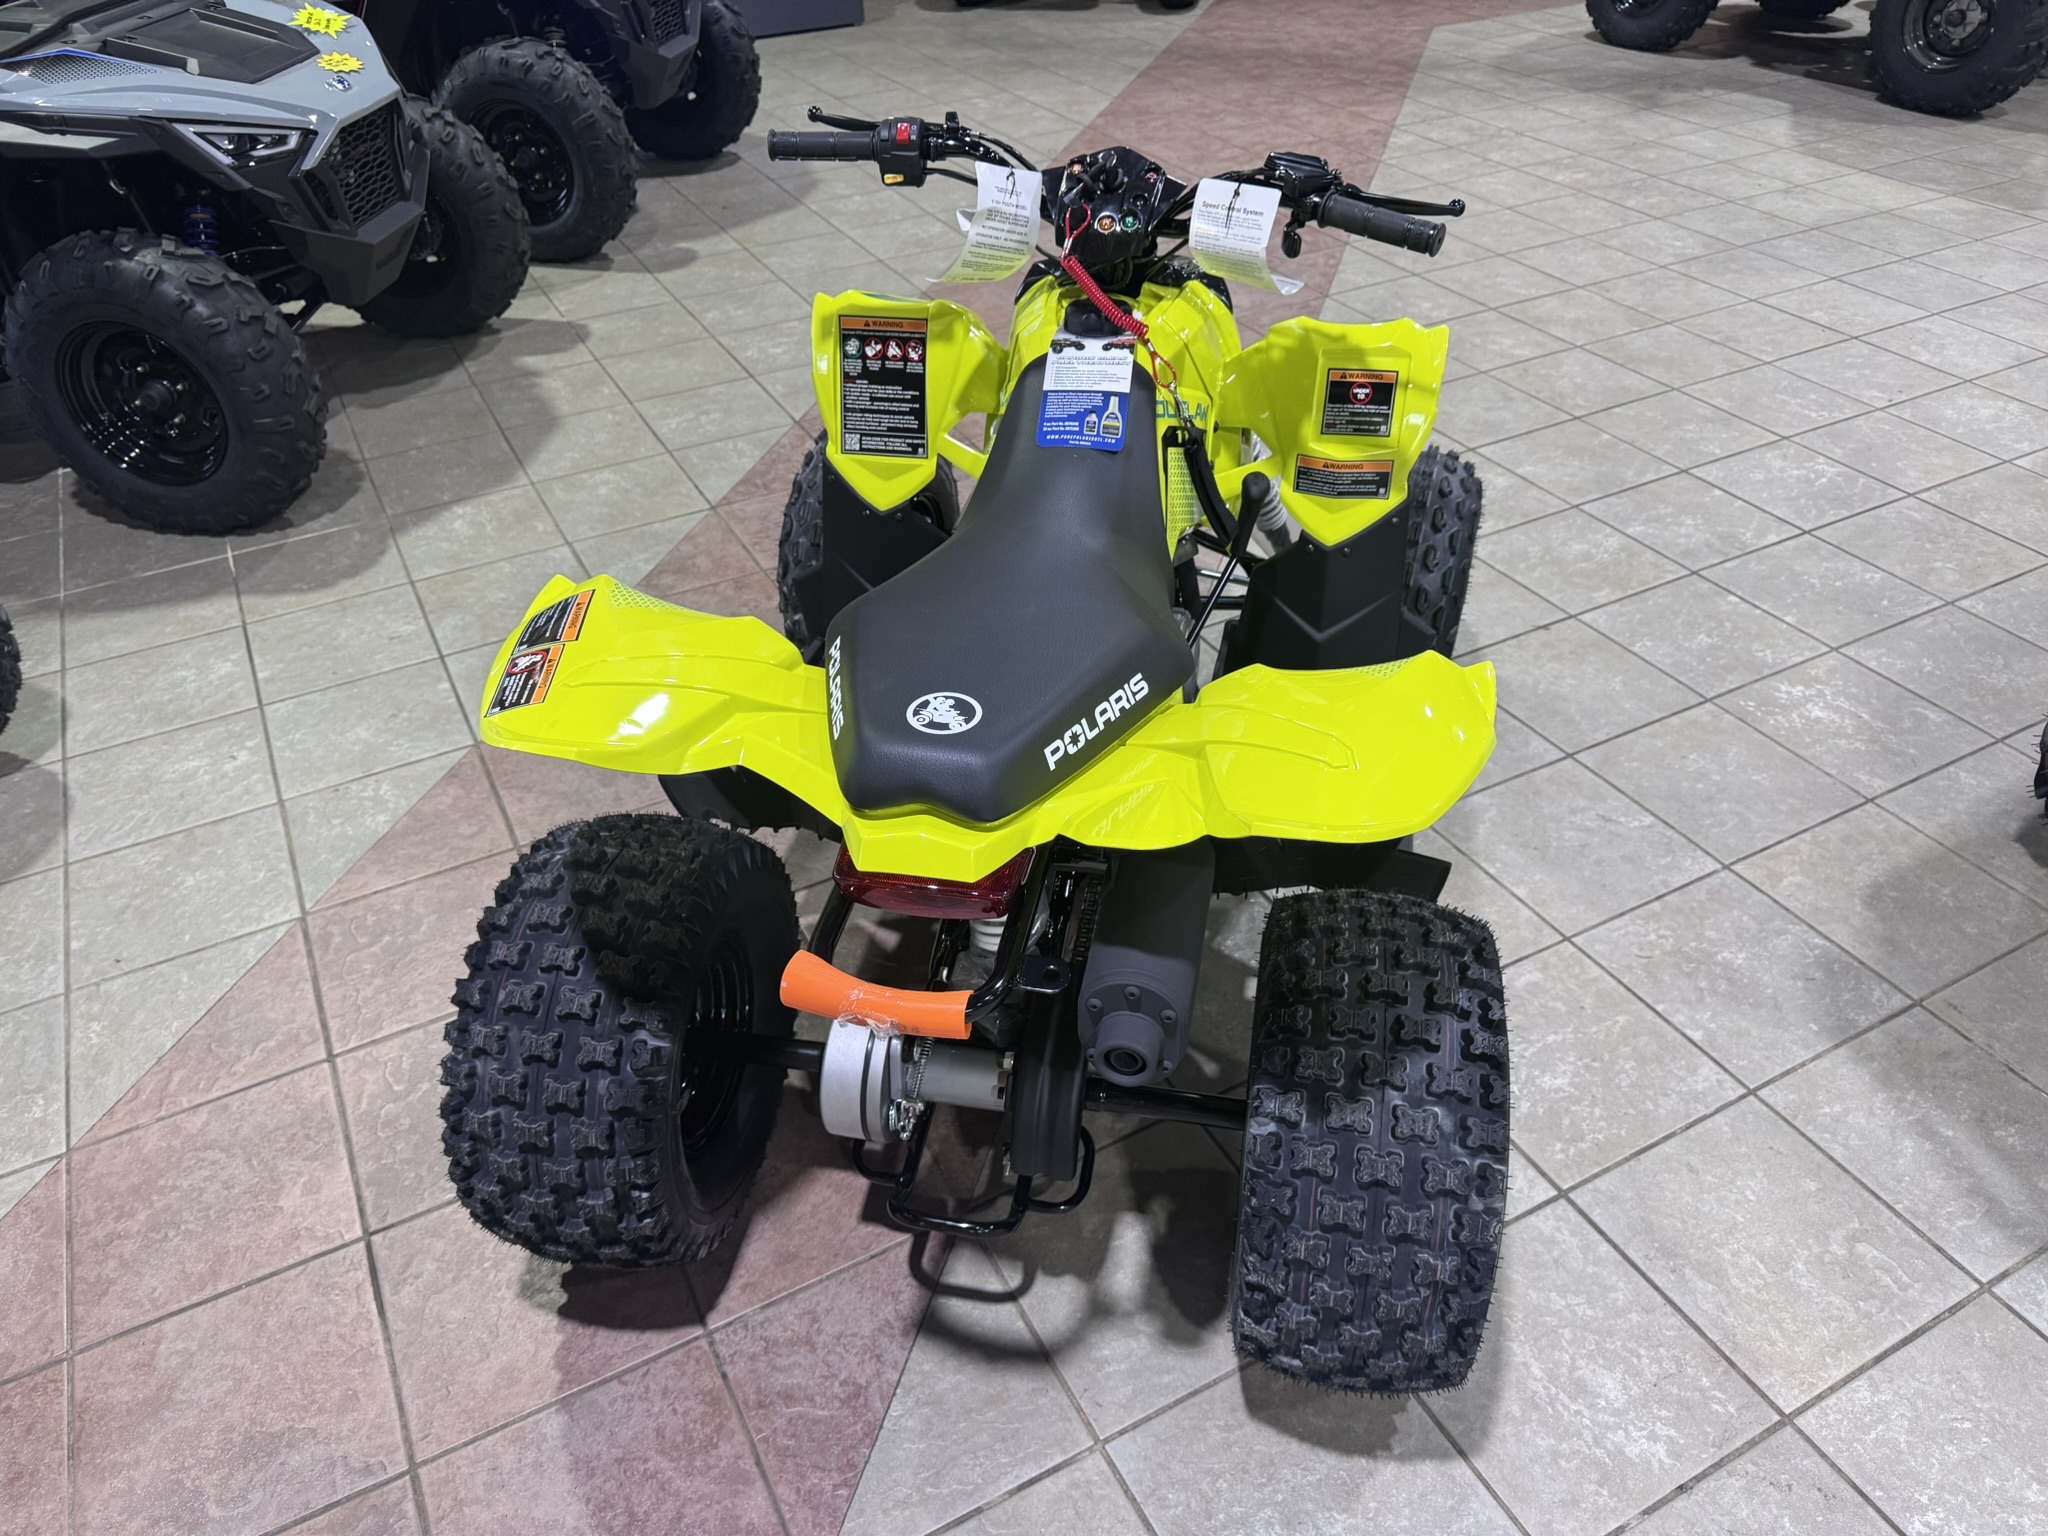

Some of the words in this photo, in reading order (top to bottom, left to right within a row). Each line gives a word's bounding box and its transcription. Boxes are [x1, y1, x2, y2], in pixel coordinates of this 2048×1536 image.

[1202, 200, 1220, 210] Speed
[1242, 207, 1264, 217] System
[872, 320, 904, 328] WARNING
[829, 635, 844, 741] POLARIS
[1043, 672, 1149, 772] POLARIS
